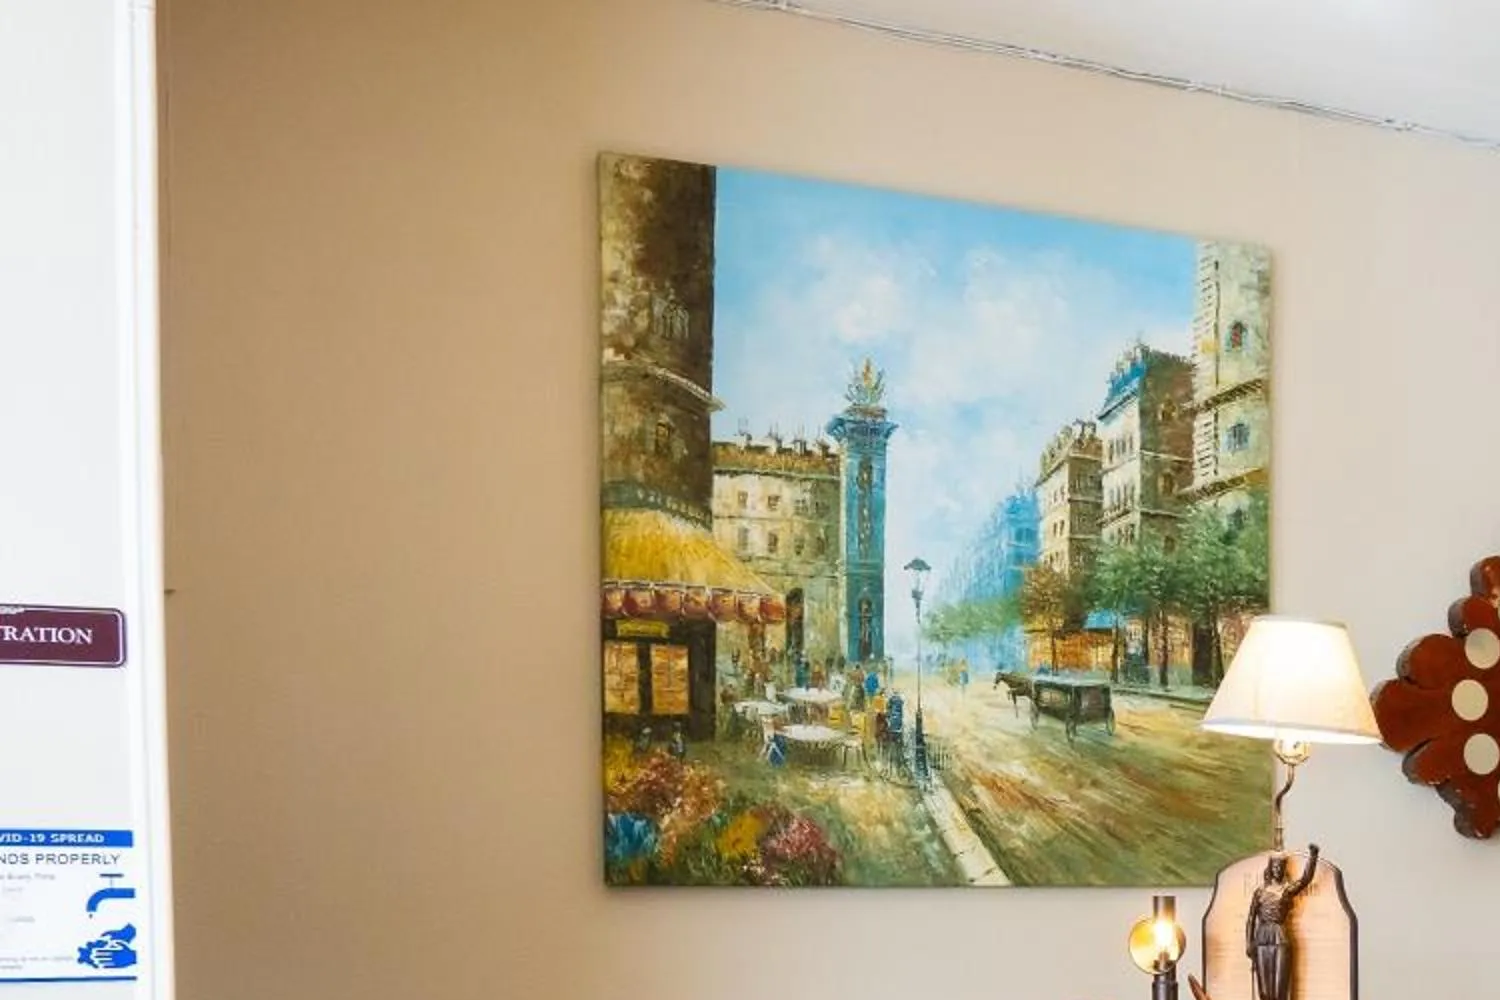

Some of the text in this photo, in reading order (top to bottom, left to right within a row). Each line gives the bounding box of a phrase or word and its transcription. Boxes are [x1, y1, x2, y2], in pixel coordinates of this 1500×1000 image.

[0, 625, 93, 645] RATION
[50, 833, 105, 843] SPREAD
[35, 852, 121, 865] PROPERLY
